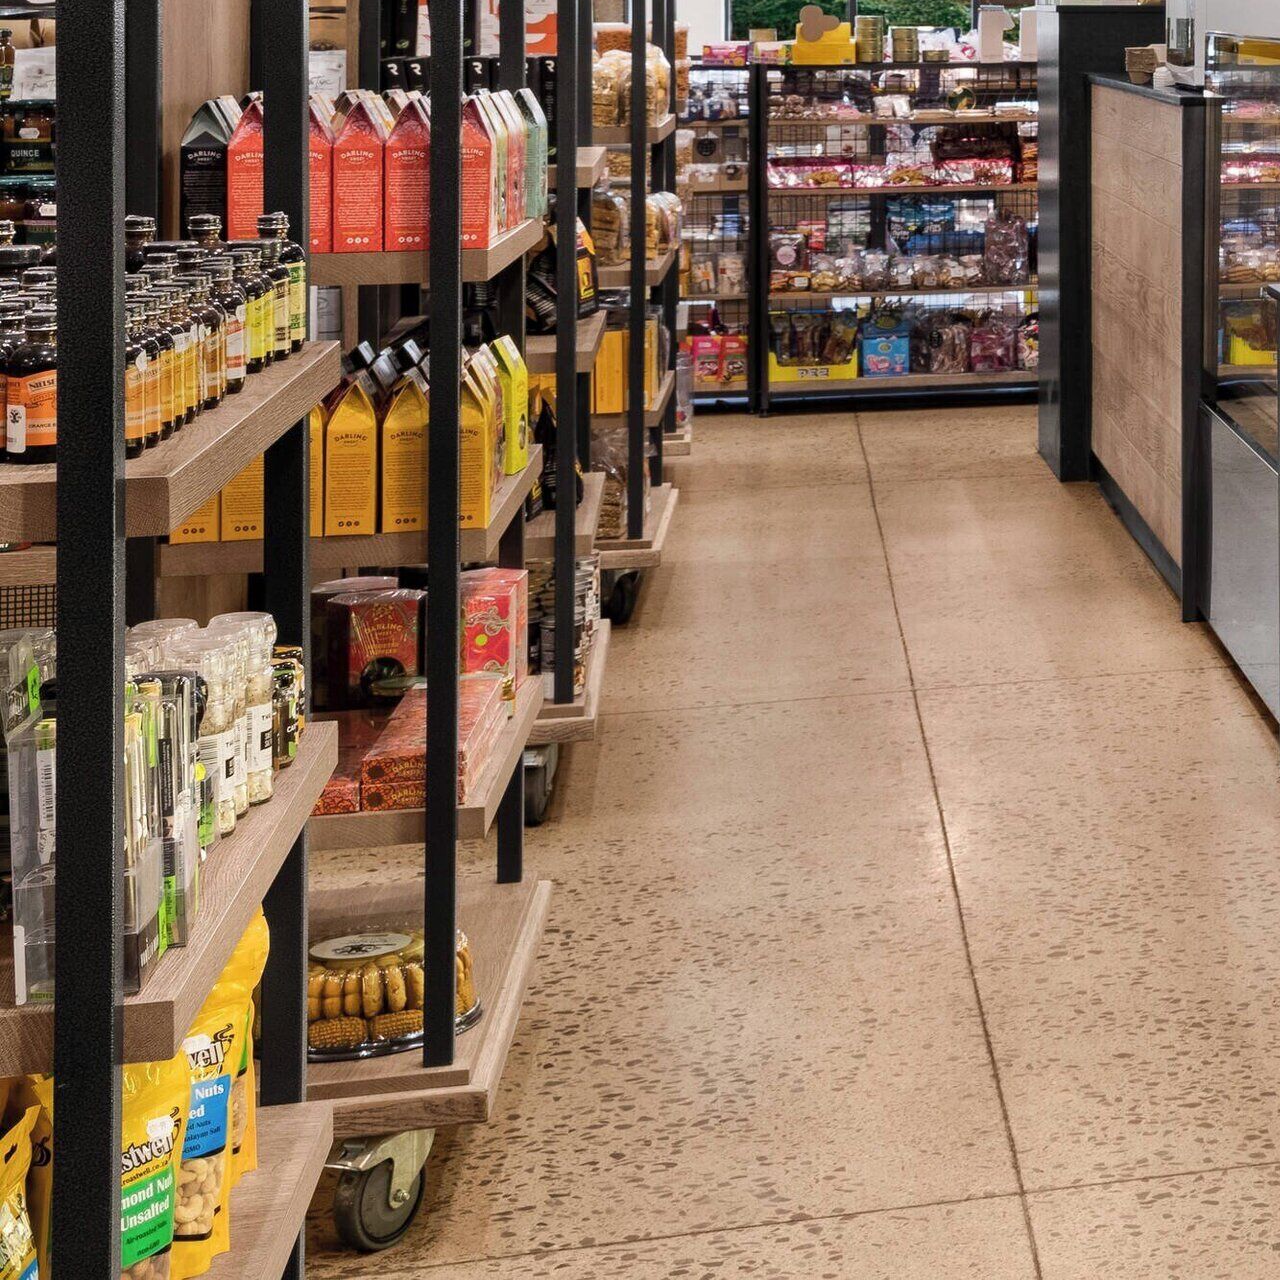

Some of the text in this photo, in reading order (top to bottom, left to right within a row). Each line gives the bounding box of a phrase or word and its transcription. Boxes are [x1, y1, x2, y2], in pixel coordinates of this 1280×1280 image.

[235, 152, 264, 161] DARLIN
[194, 1083, 225, 1100] Nuts
[120, 1194, 170, 1232] Unsalted
